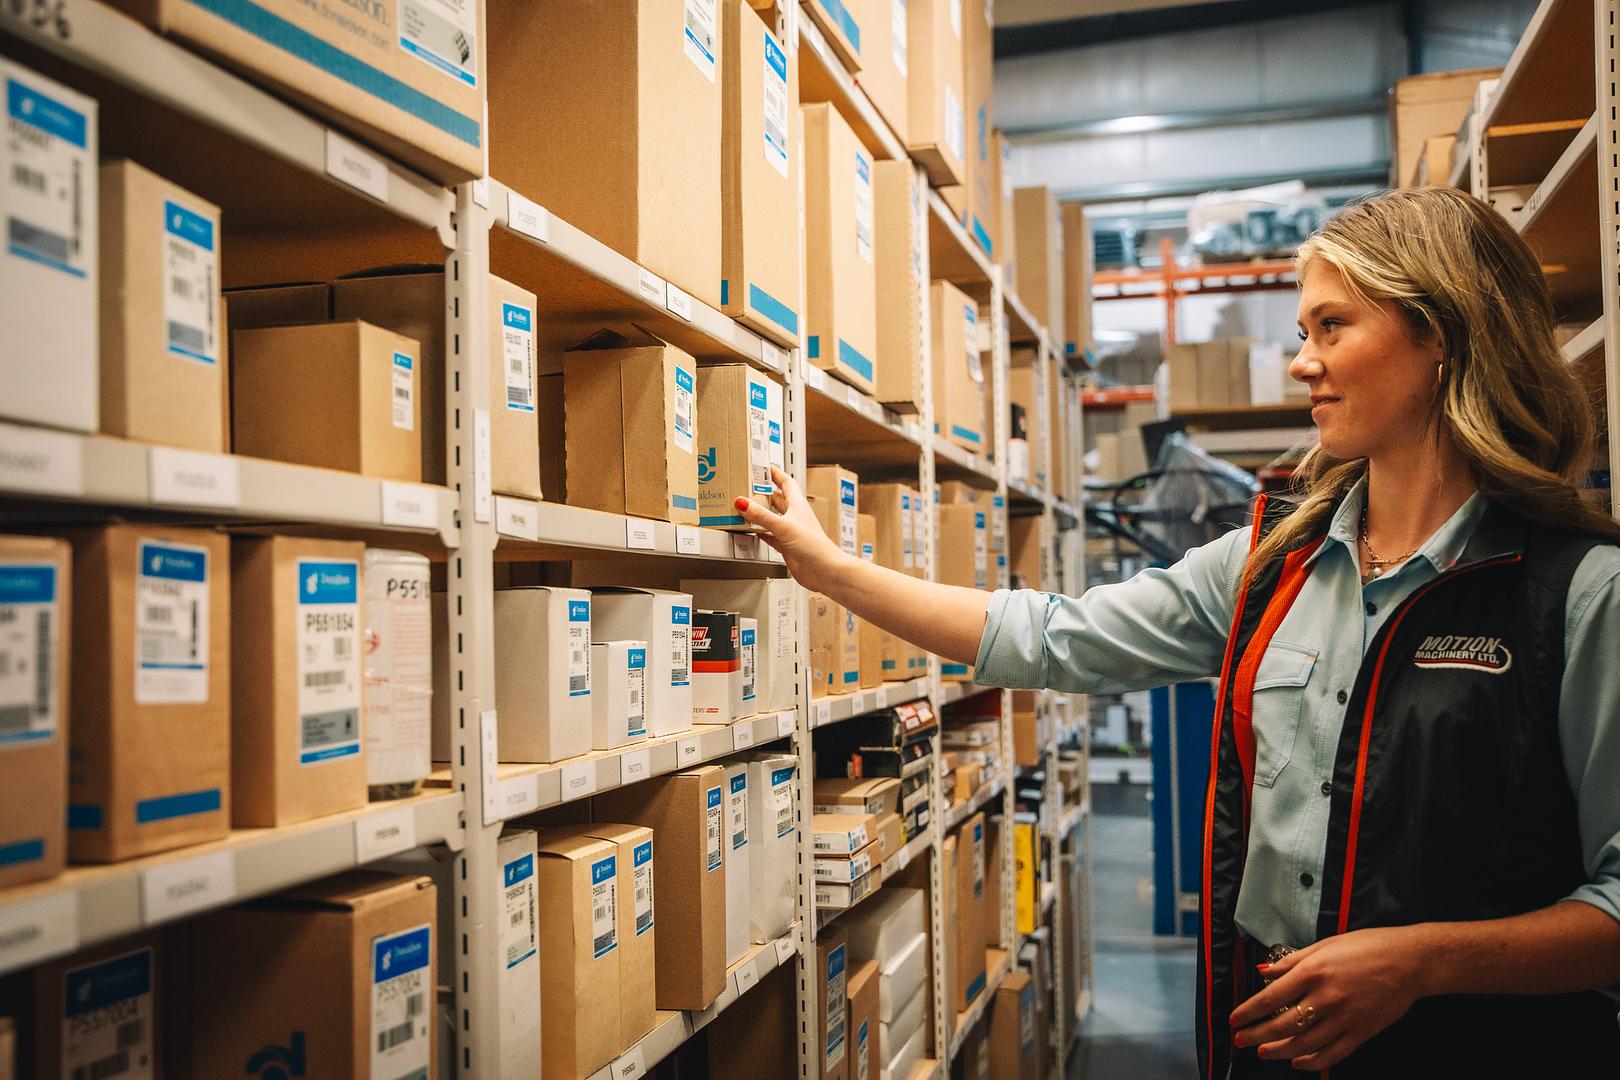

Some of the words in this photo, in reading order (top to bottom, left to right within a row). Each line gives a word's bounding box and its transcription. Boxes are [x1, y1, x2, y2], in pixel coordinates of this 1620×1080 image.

[698, 490, 725, 500] aldson
[1418, 636, 1501, 653] MOTION
[1414, 650, 1475, 660] MACHINERY
[1478, 653, 1500, 664] LTD.
